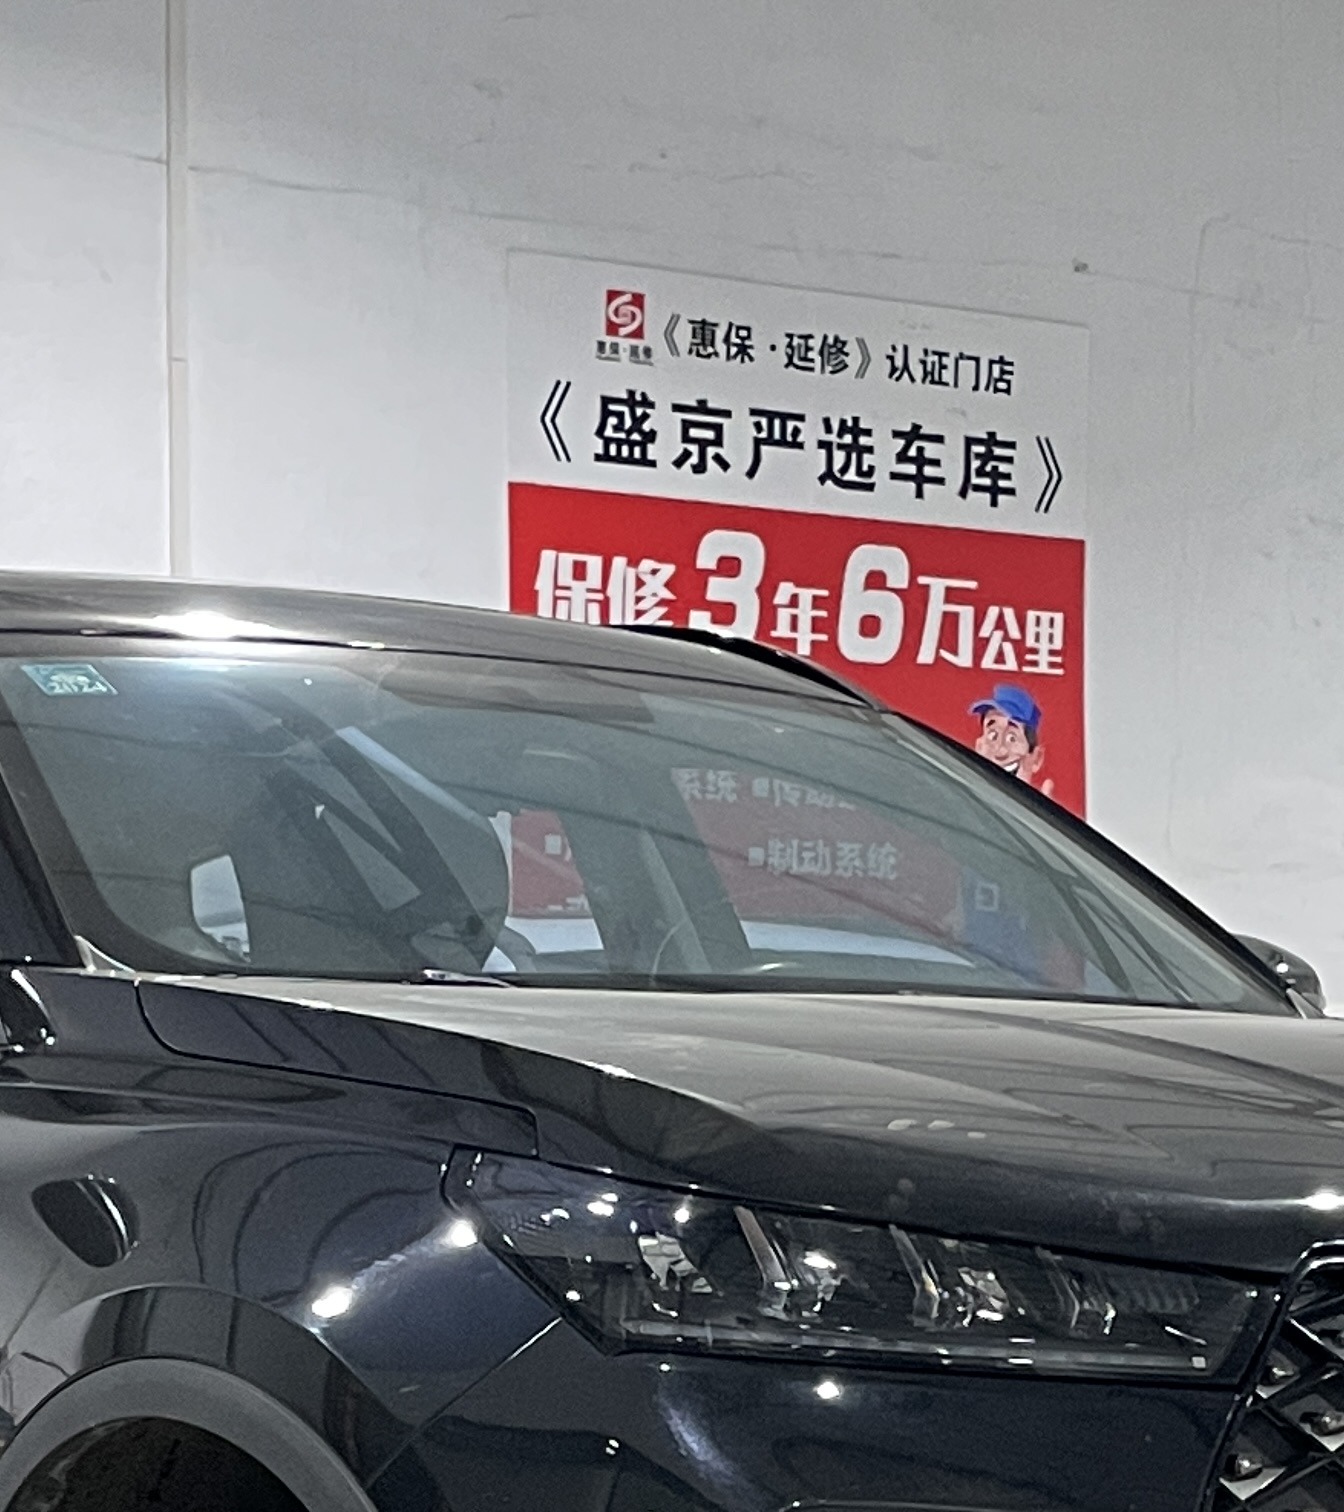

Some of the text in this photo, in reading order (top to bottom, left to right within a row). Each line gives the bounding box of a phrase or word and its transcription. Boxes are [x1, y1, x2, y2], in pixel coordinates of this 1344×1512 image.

[539, 379, 1064, 514] 《盛京严选车库》
[534, 528, 1066, 676] 保修3年6万公里
